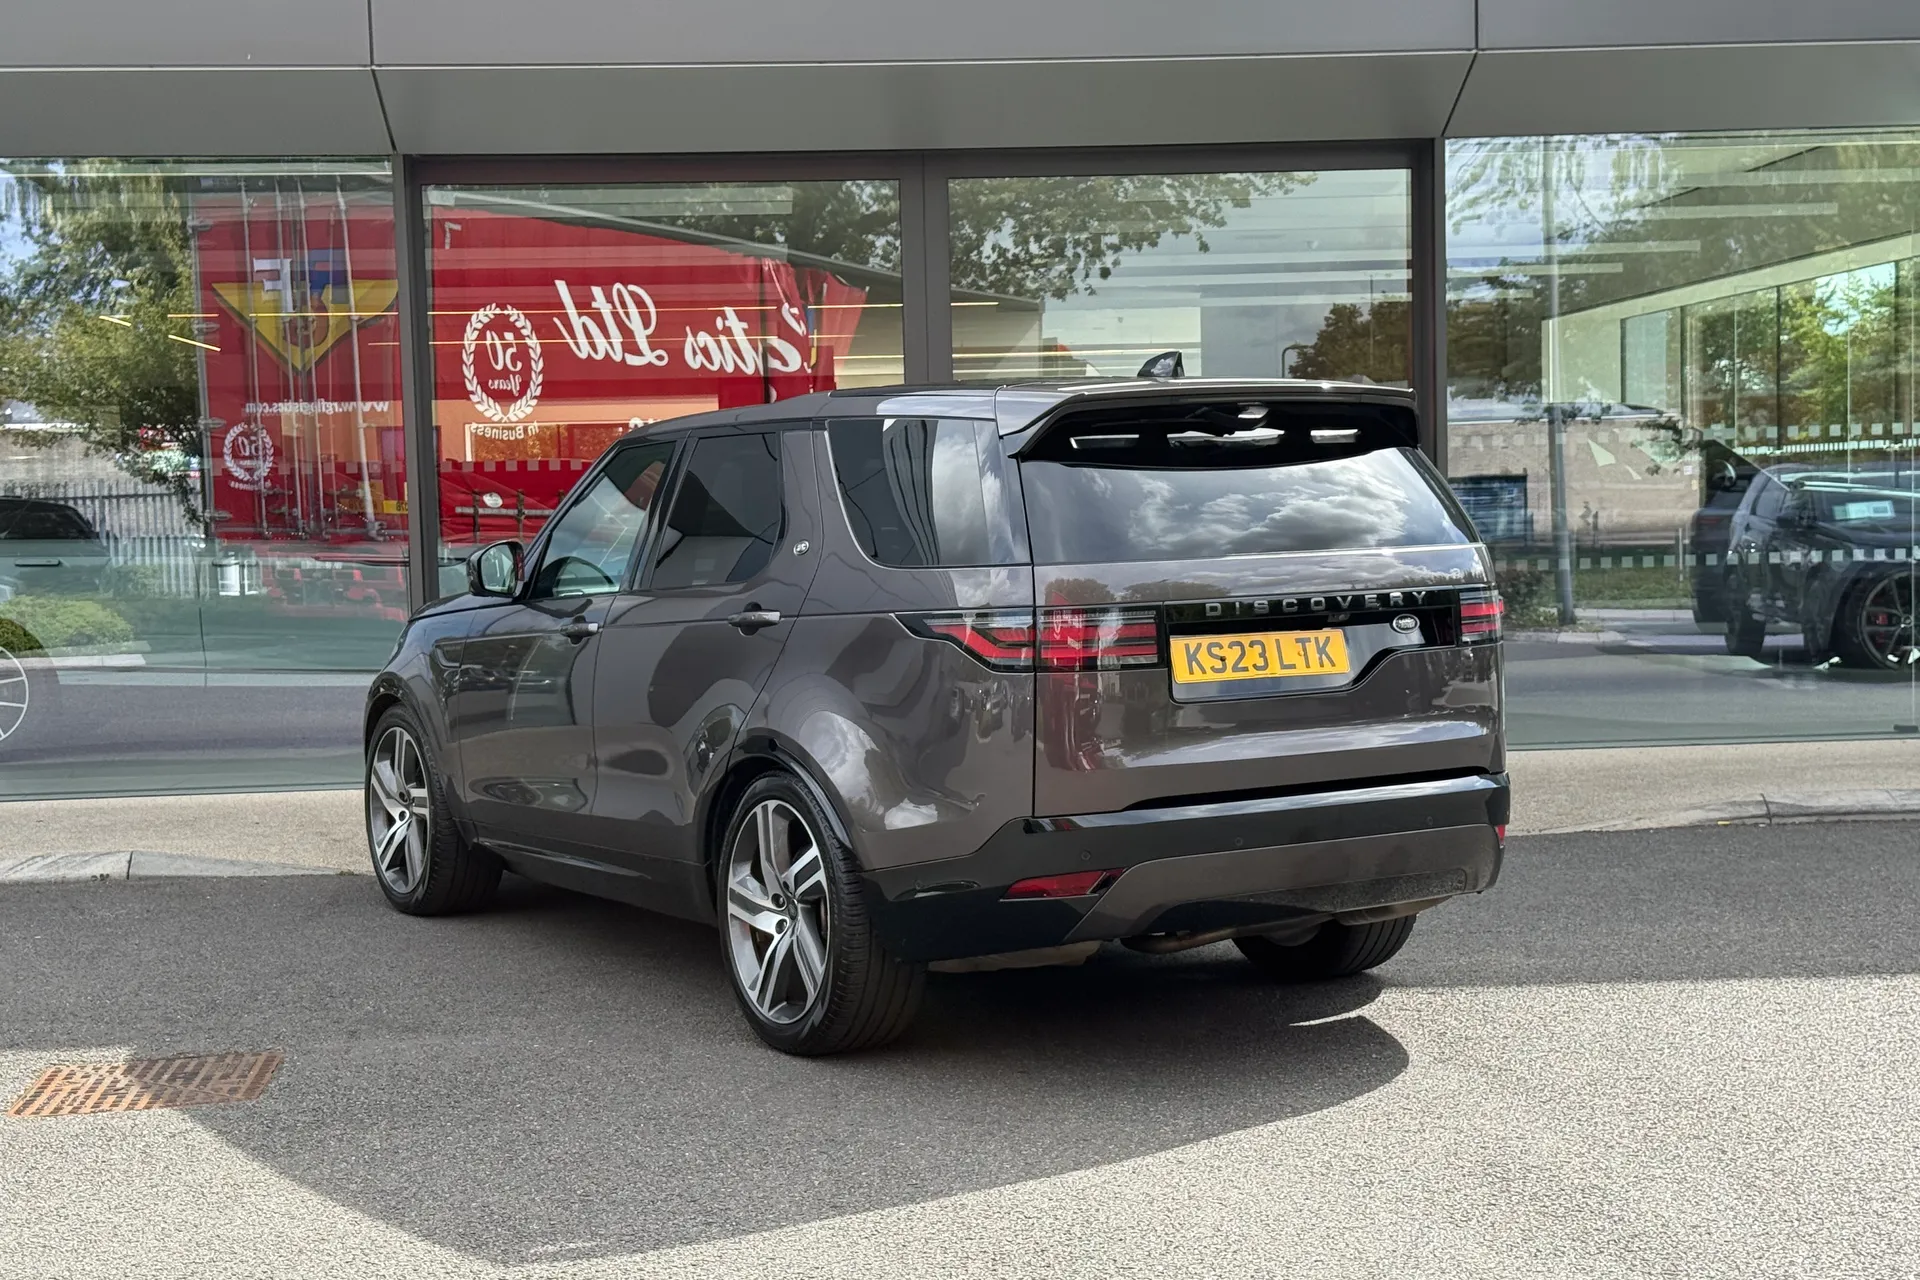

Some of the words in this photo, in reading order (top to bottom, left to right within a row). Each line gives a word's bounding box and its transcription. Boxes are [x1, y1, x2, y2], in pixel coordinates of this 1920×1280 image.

[1205, 591, 1426, 616] DISCOVERY
[1184, 639, 1268, 675] KS23
[1275, 636, 1336, 670] LTK
